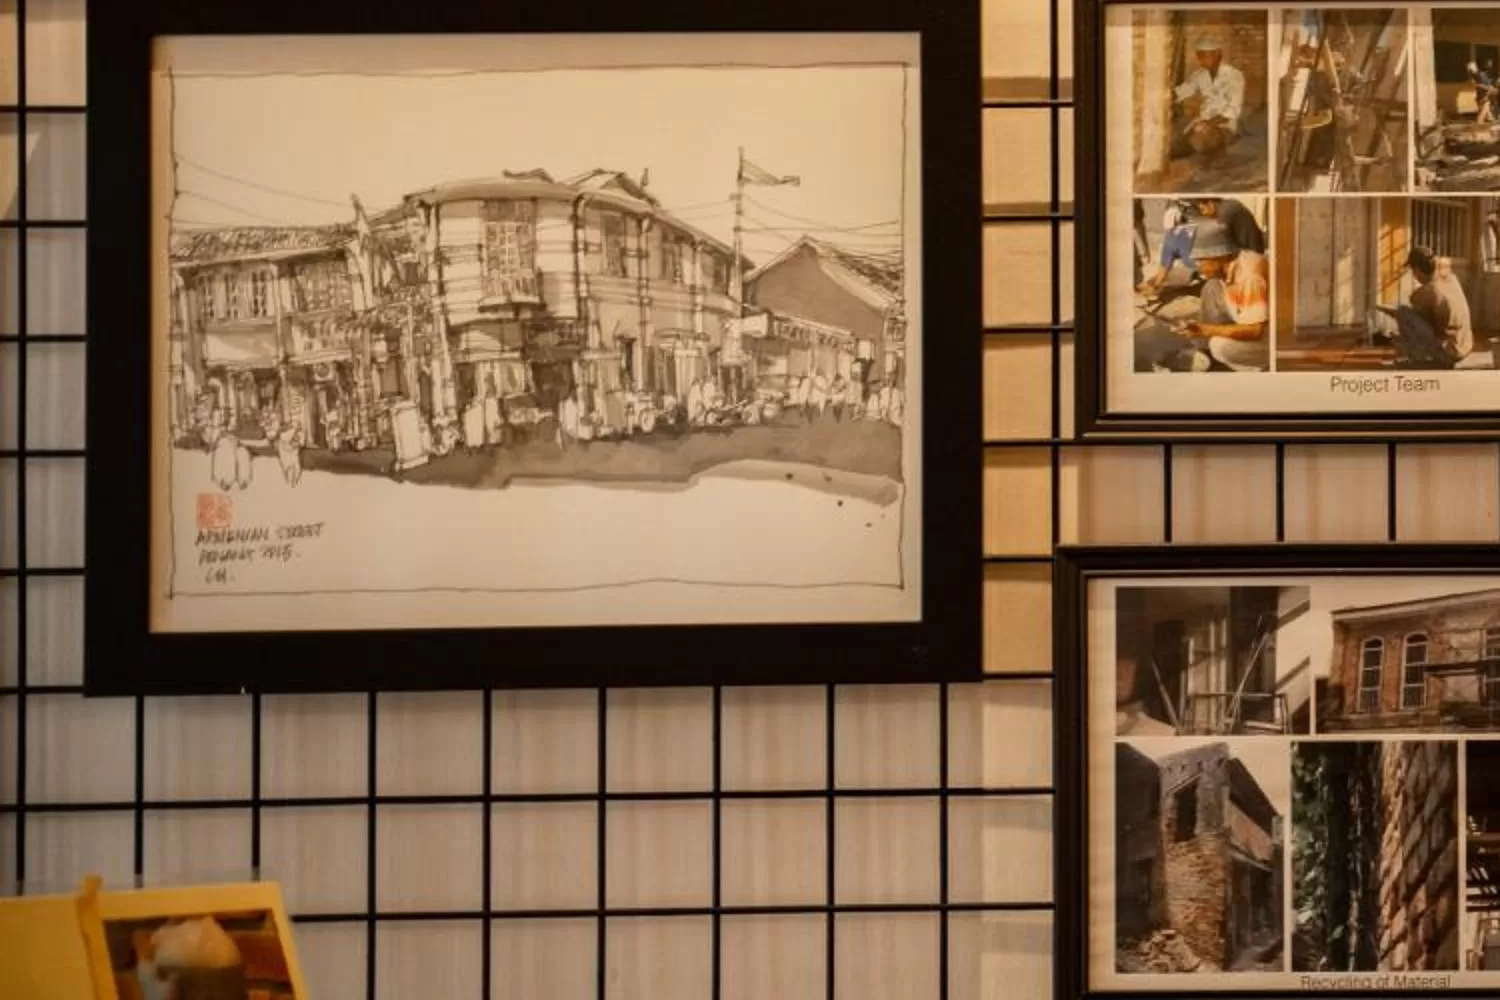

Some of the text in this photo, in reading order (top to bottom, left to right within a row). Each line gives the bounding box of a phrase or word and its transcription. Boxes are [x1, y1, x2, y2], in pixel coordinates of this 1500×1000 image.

[1330, 375, 1440, 396] Project Team
[1301, 976, 1451, 989] Recycling of Material
